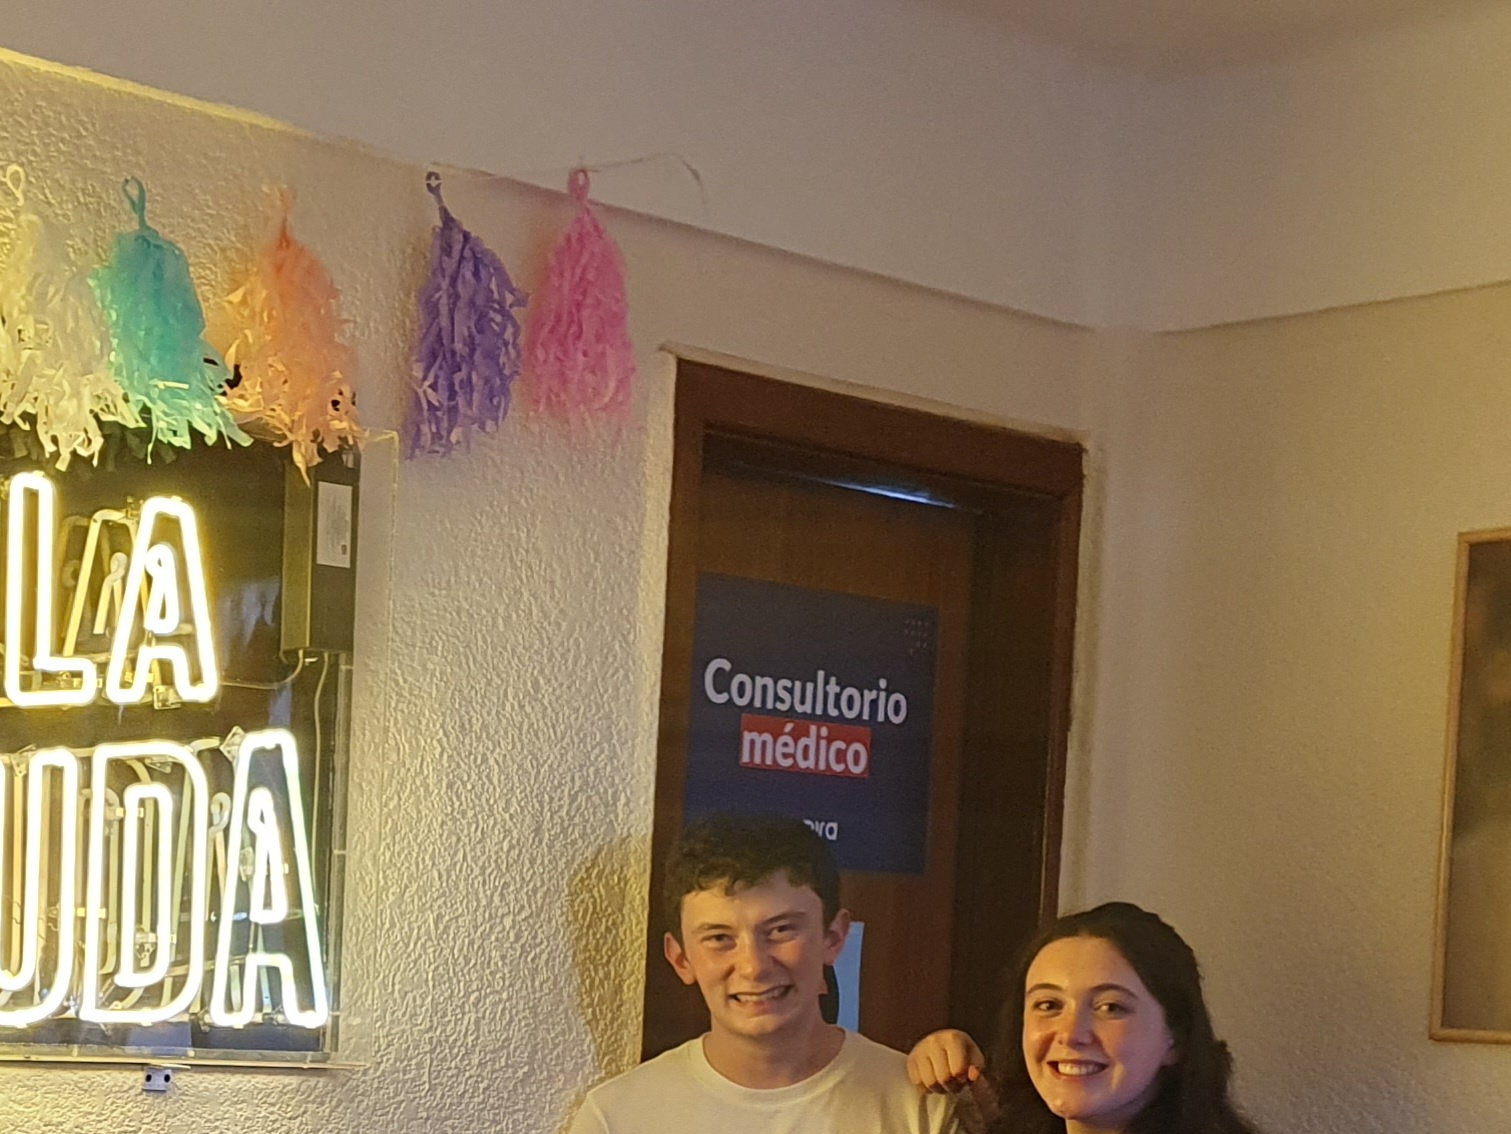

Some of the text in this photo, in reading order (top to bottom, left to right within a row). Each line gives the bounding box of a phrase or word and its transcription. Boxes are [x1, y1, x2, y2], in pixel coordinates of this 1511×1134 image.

[4, 470, 218, 707] LA
[703, 657, 908, 725] Consultorio
[740, 723, 869, 774] médico
